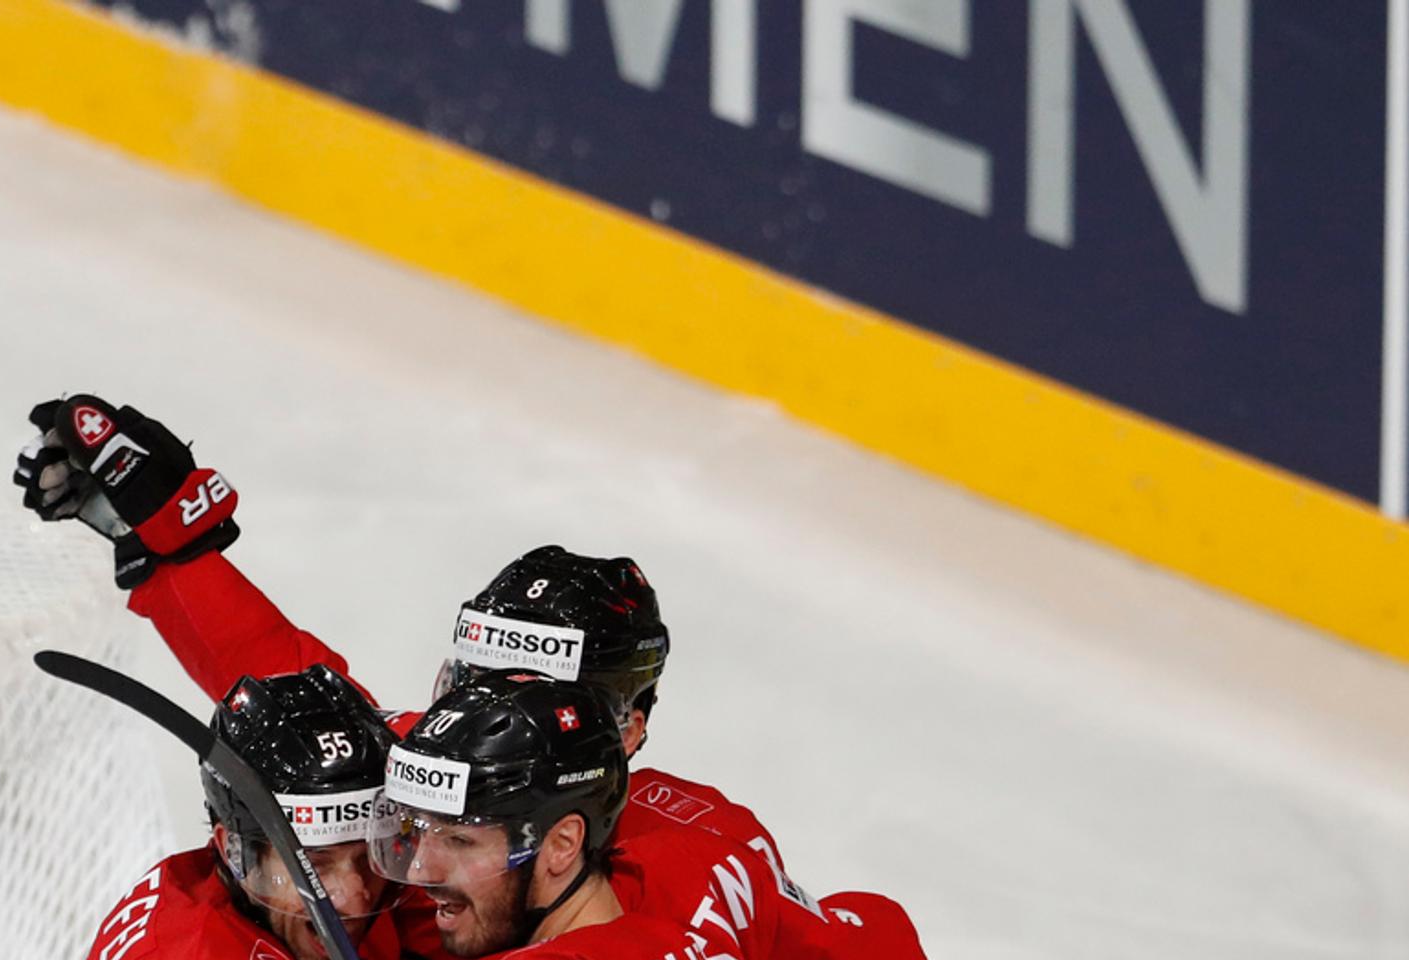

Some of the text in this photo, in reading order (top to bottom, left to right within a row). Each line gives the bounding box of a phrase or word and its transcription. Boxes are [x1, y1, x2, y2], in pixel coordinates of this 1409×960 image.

[526, 579, 549, 599] 8
[484, 625, 580, 658] TISSOT
[476, 646, 519, 663] WATCHES
[522, 654, 551, 669] SINCE
[420, 709, 464, 738] 70
[315, 731, 353, 762] 55
[394, 760, 461, 790] TISSOT
[556, 767, 606, 786] BAUER
[295, 849, 327, 900] BAUER
